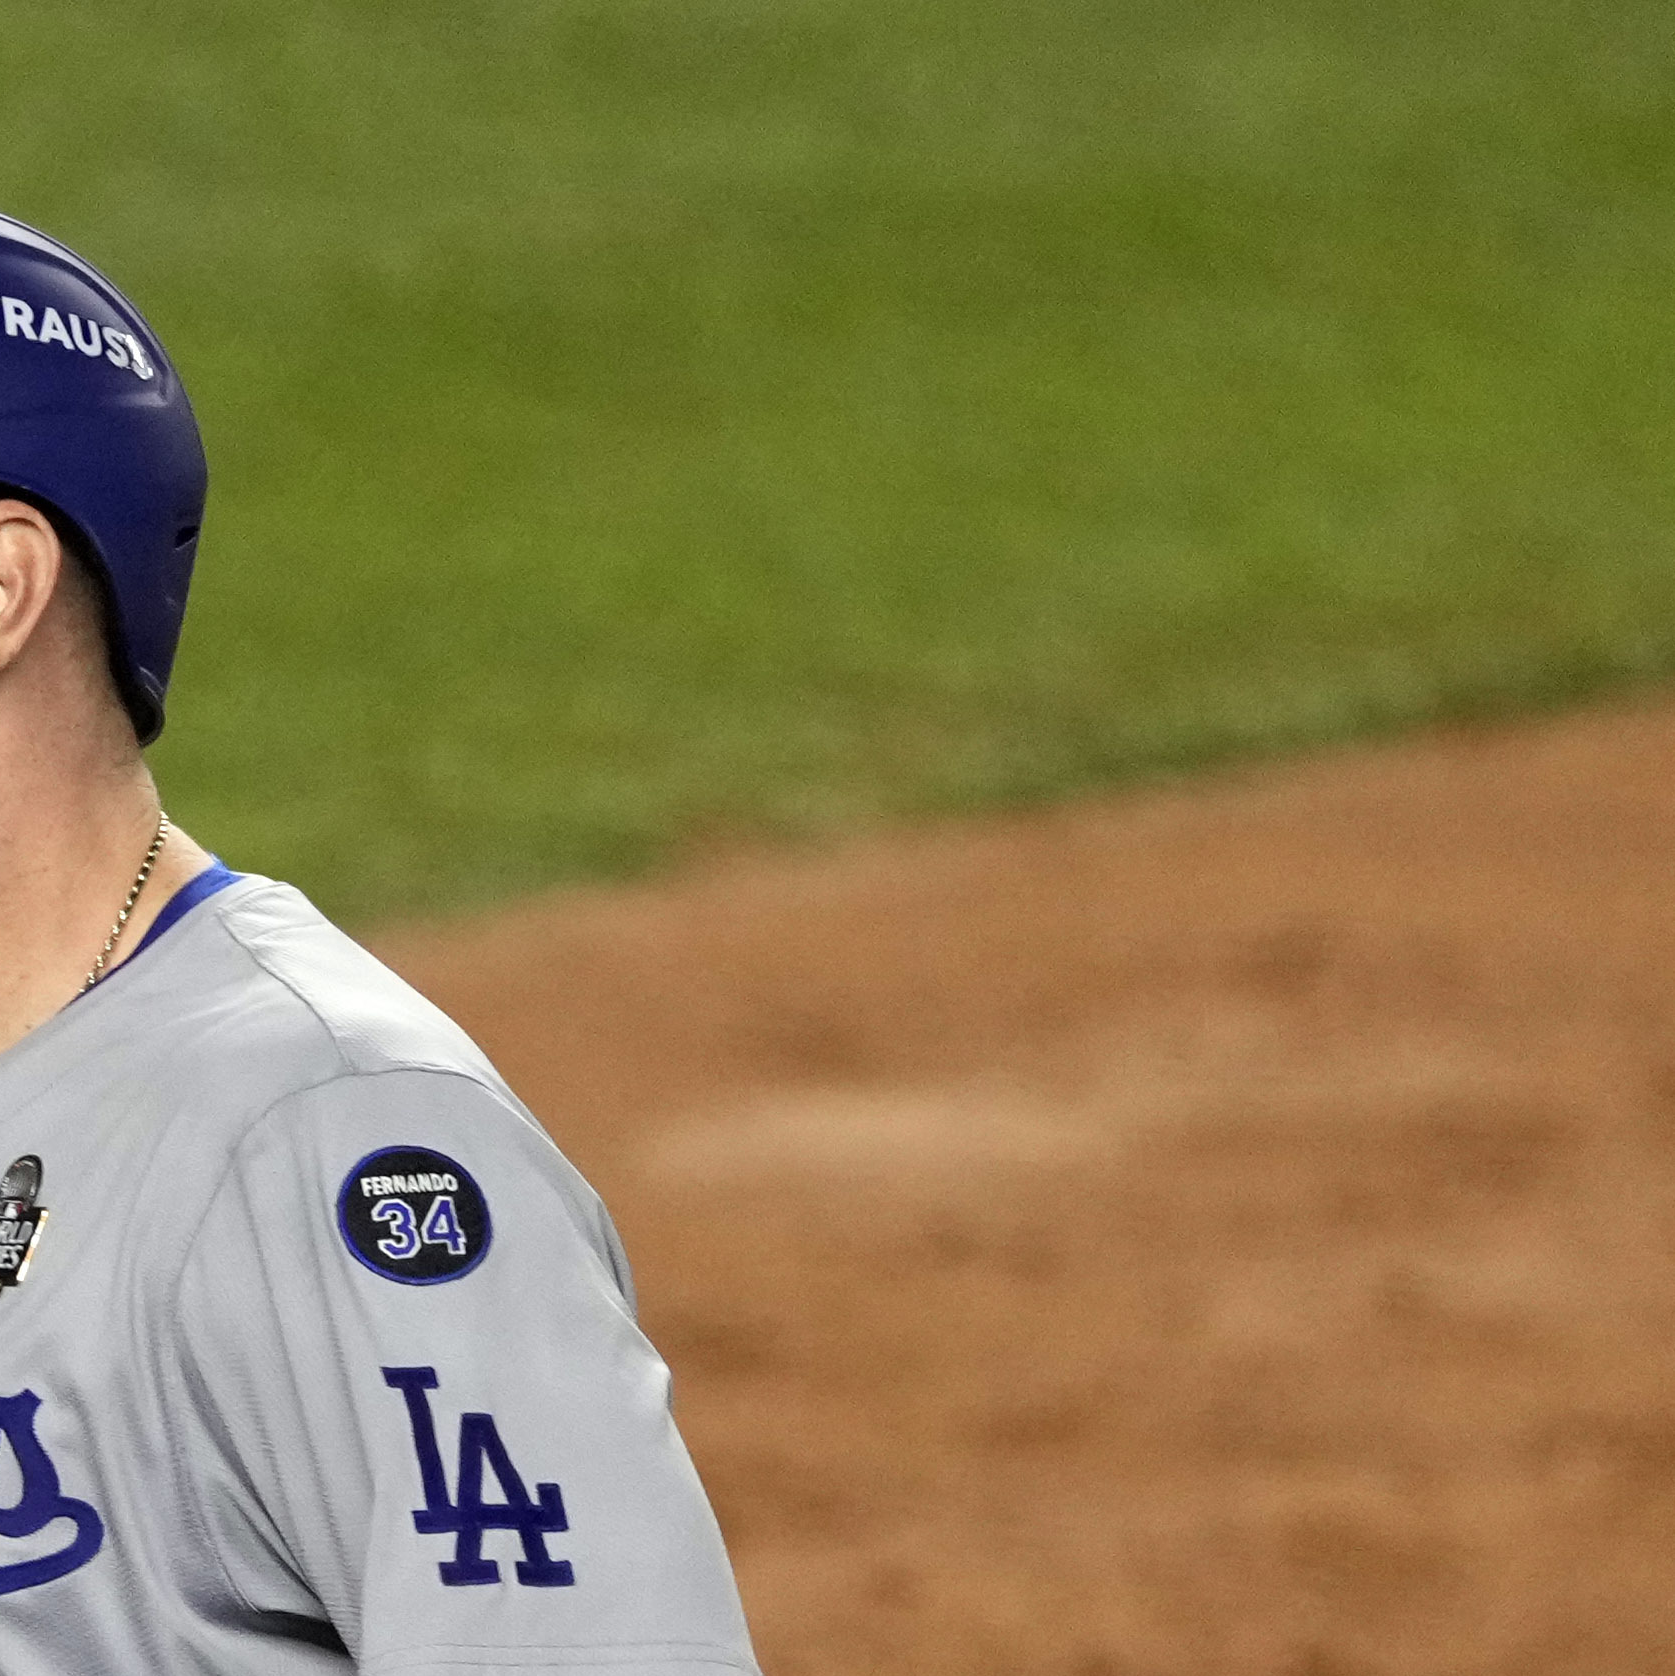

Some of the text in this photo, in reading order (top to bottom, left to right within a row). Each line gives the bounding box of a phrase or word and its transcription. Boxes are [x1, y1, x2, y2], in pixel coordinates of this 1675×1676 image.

[360, 1173, 459, 1198] FERNANDO
[370, 1195, 467, 1260] 34
[379, 1365, 576, 1587] LA
